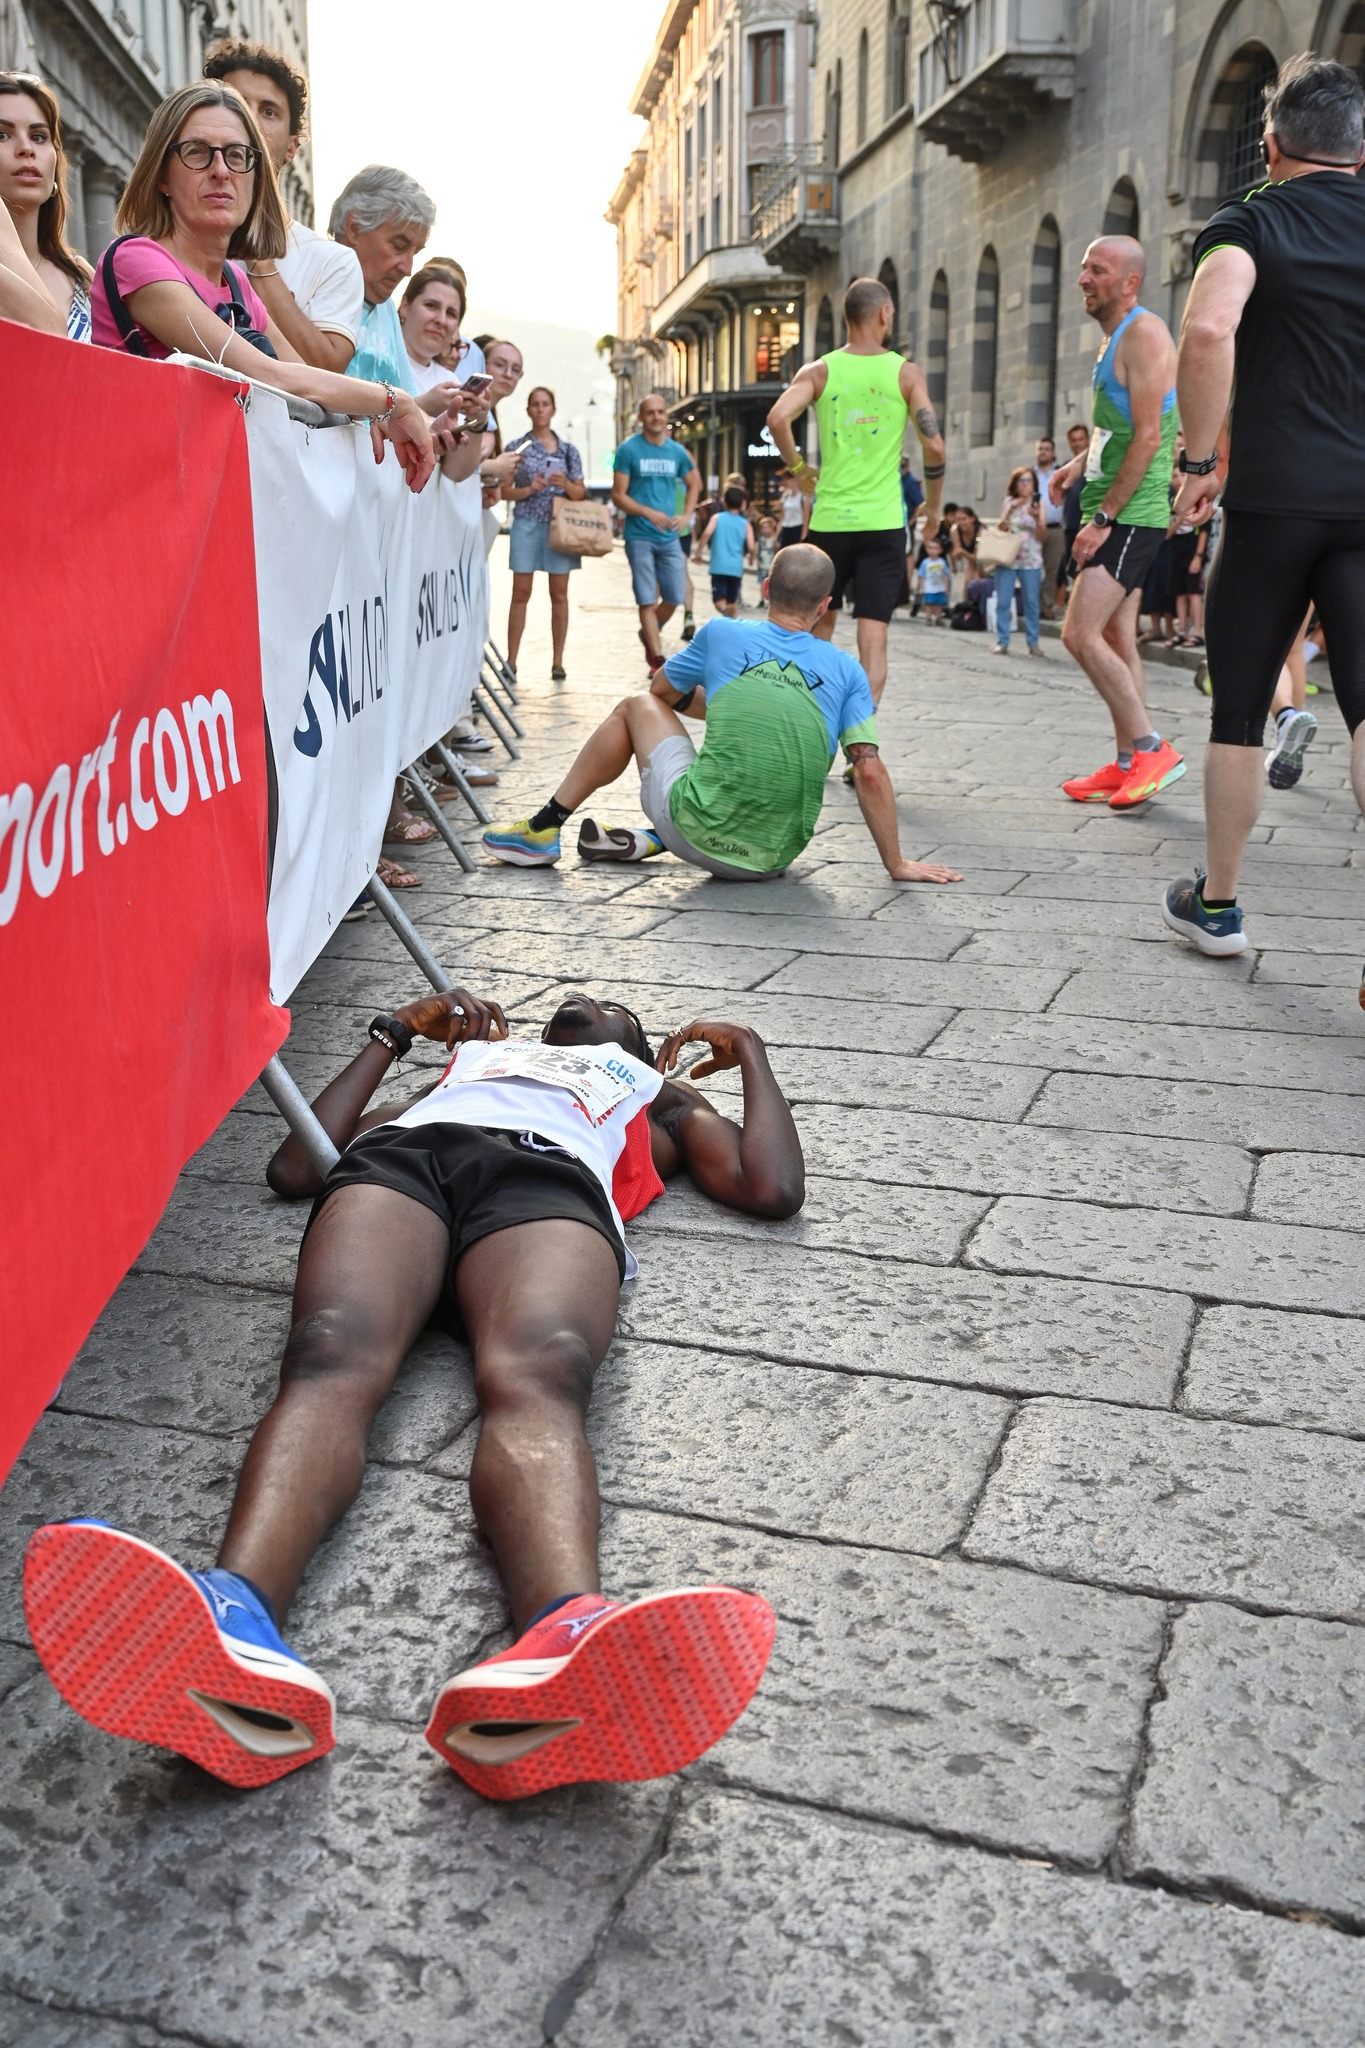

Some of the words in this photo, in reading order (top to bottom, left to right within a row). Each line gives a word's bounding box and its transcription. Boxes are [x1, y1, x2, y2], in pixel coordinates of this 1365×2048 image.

[523, 1051, 592, 1075] 123
[594, 1064, 621, 1085] RUN
[606, 1059, 636, 1085] CUS
